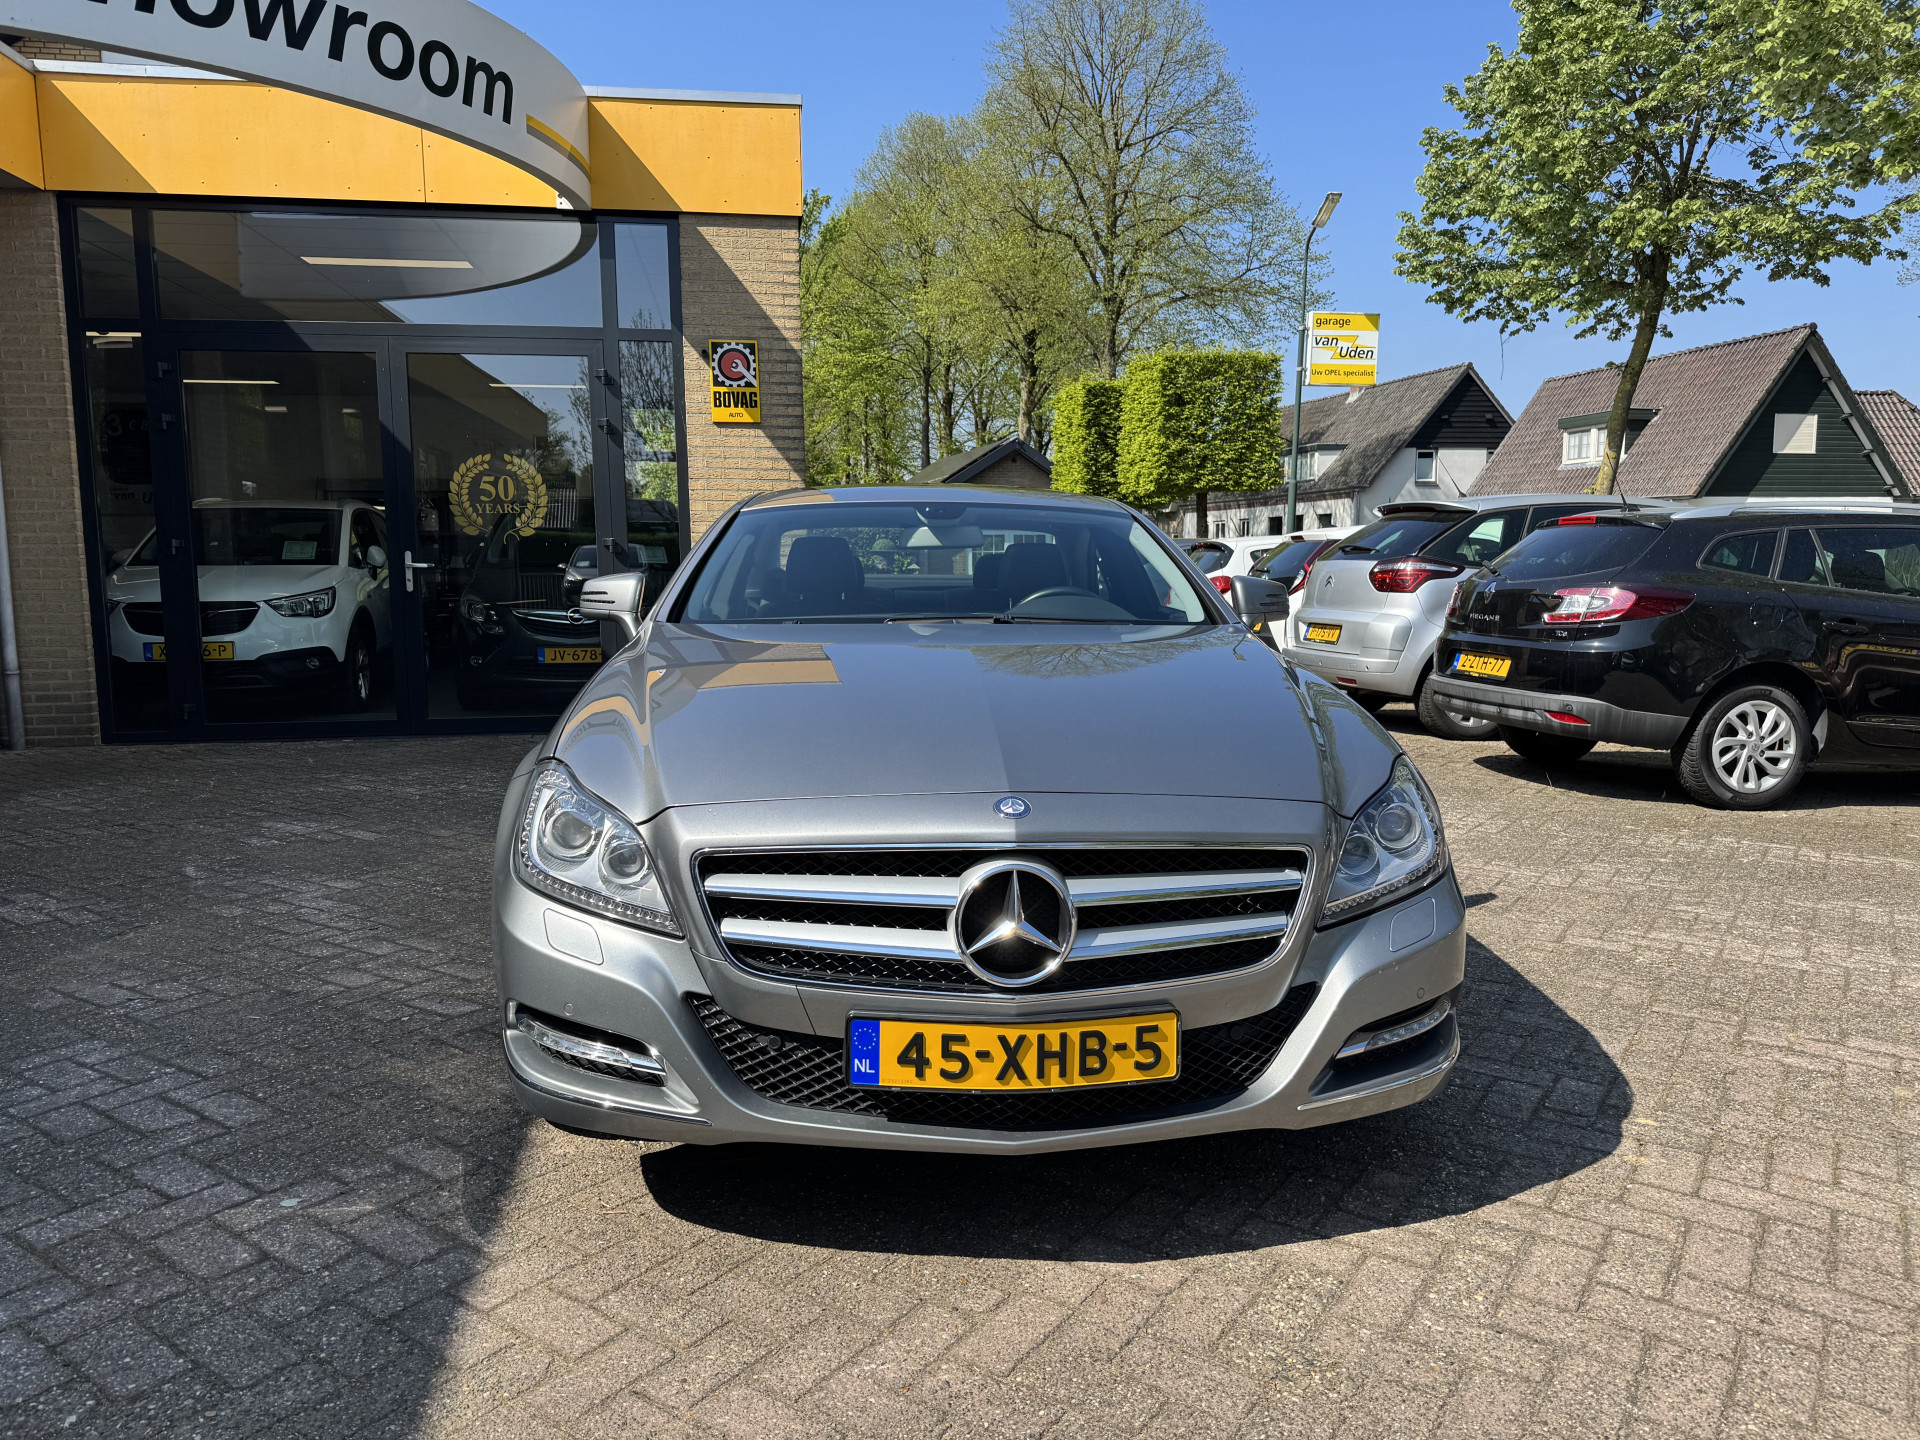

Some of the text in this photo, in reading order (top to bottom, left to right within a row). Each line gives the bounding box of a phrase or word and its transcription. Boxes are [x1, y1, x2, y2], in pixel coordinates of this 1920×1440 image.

[1315, 317, 1351, 328] garage
[1315, 336, 1339, 347] van
[1339, 346, 1374, 359] Uden
[1343, 369, 1374, 377] specialist
[713, 390, 758, 409] BOVAG
[479, 475, 515, 501] 50
[475, 503, 521, 514] YEARS
[1461, 653, 1506, 673] 2-ZTH-77
[896, 1024, 1163, 1082] 45-XHB-5
[854, 1058, 876, 1073] NL
